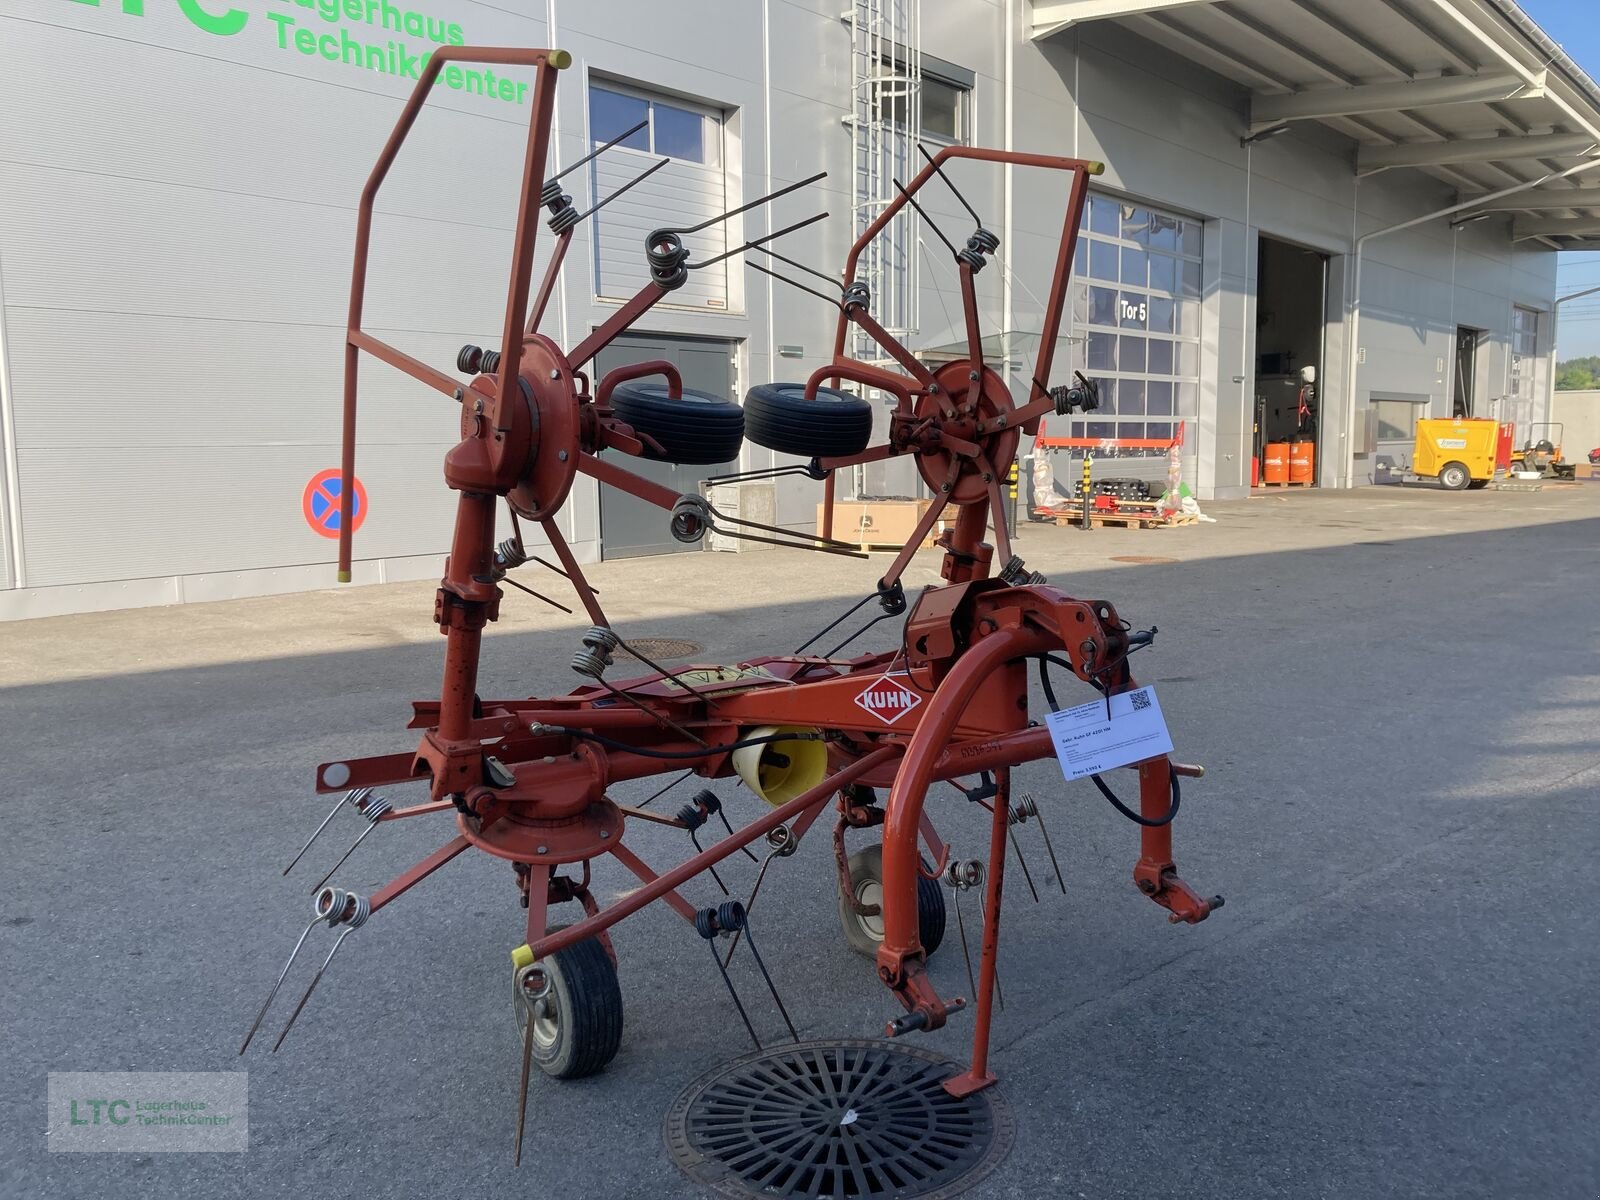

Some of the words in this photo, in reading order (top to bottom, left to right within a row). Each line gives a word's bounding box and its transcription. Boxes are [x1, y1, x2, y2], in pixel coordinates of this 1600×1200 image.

[280, 0, 464, 46] gerhaus
[1121, 300, 1138, 320] Tor
[1139, 303, 1146, 321] 5
[863, 691, 912, 708] KUHN
